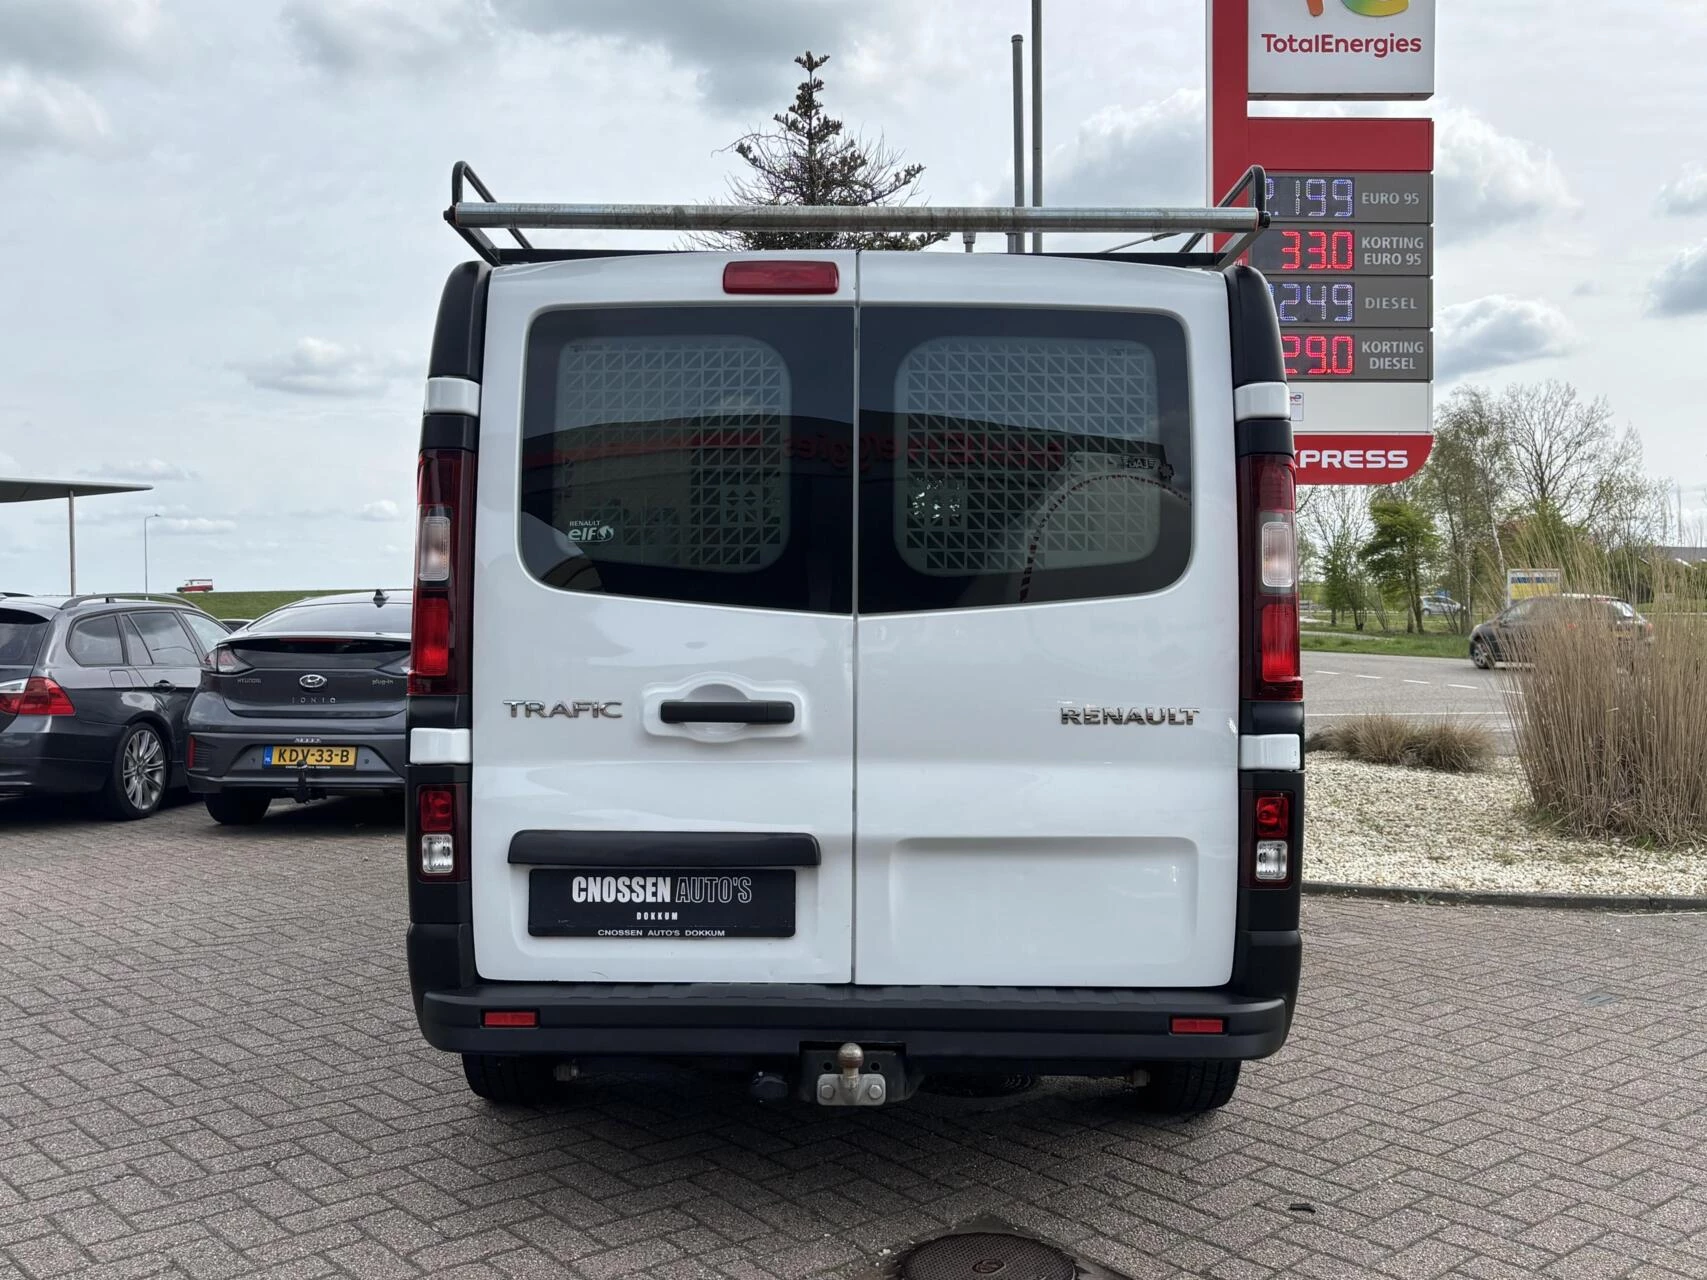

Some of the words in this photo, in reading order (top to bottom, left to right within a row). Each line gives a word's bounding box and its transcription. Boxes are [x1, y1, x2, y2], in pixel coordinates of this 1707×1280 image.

[1261, 33, 1422, 58] TotalEnergies
[1362, 192, 1400, 205] EURO
[1403, 192, 1420, 205] 95
[1361, 237, 1424, 249] KORTING
[1281, 231, 1353, 269] 33.0
[1364, 253, 1402, 265] EURO
[1406, 253, 1422, 265] 95
[1364, 297, 1417, 309] DIESEL
[1361, 341, 1424, 353] KORTING
[1281, 335, 1353, 374] 29.0
[1369, 357, 1416, 370] DIESEL
[568, 527, 597, 541] elf
[503, 699, 623, 718] TRAFIC
[1060, 707, 1200, 725] RENAULT
[278, 748, 350, 763] KDV-33-B
[572, 876, 671, 903] CNOSSEN
[675, 876, 752, 903] AUTO'S
[636, 911, 678, 921] DOKKUM
[597, 929, 643, 937] CNOSSEN
[647, 929, 680, 937] AUTO'S
[685, 929, 725, 937] DOKKUM
